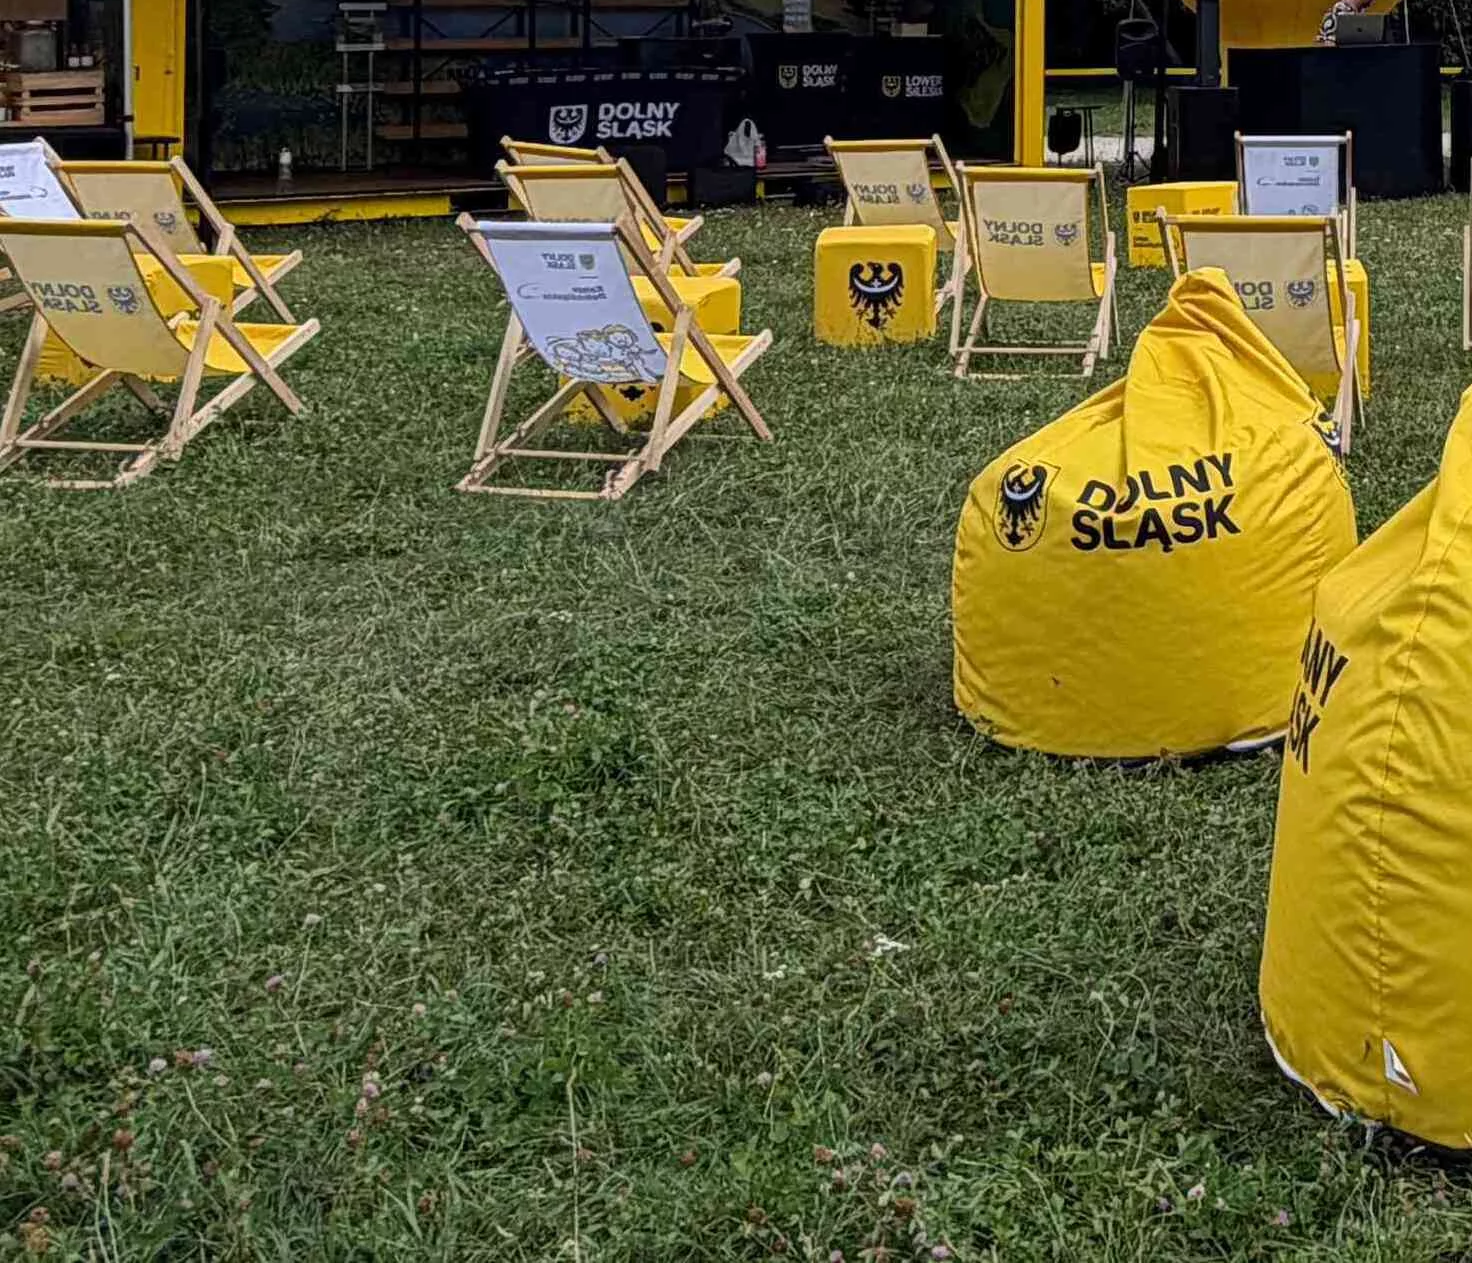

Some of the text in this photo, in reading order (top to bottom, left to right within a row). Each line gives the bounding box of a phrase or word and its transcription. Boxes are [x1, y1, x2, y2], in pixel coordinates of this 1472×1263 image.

[802, 64, 838, 77] DOLNY
[906, 75, 943, 87] LOWER
[598, 102, 681, 120] DOLNY
[596, 119, 673, 140] ŚLĄSK
